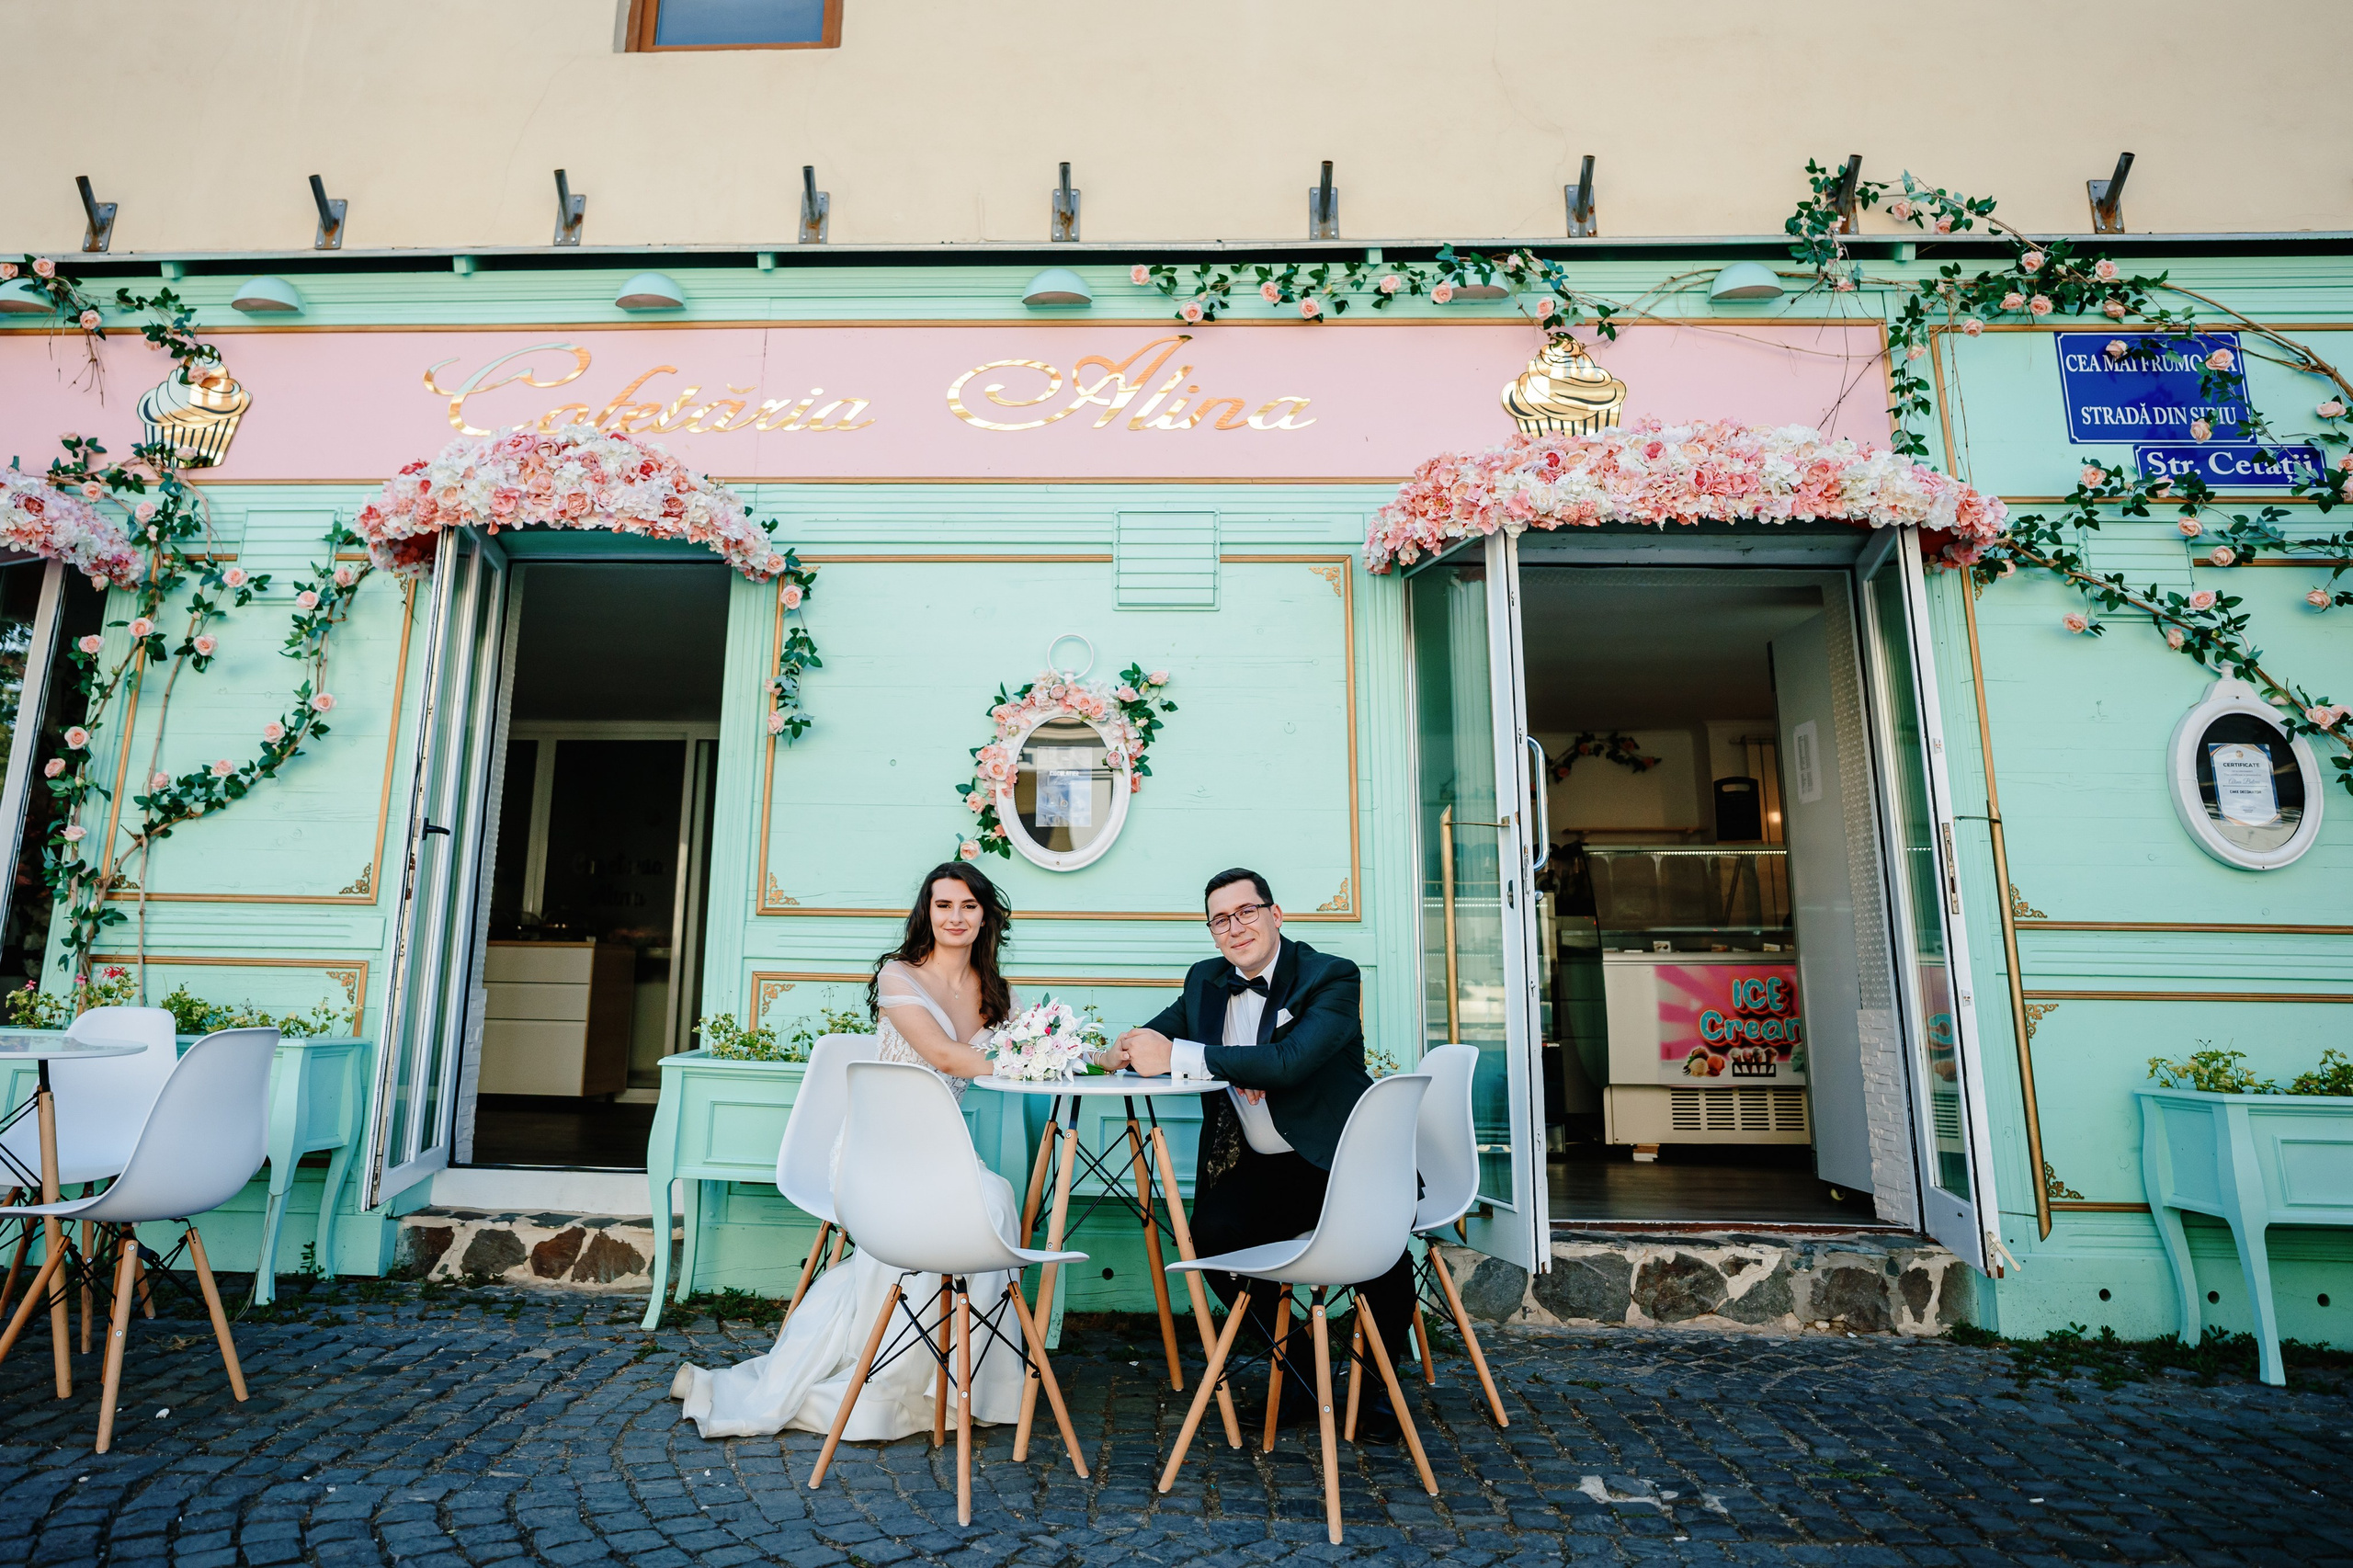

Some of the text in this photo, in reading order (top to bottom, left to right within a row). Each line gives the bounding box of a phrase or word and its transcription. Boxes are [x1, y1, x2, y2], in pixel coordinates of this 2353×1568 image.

[2065, 354, 2238, 372] CEA MAI FRUMO
[946, 334, 1319, 432] Alina
[2081, 403, 2153, 426] STRADĂ
[2153, 406, 2188, 426] DIN
[2146, 451, 2201, 476] Str.
[1732, 976, 1784, 1011] ICE
